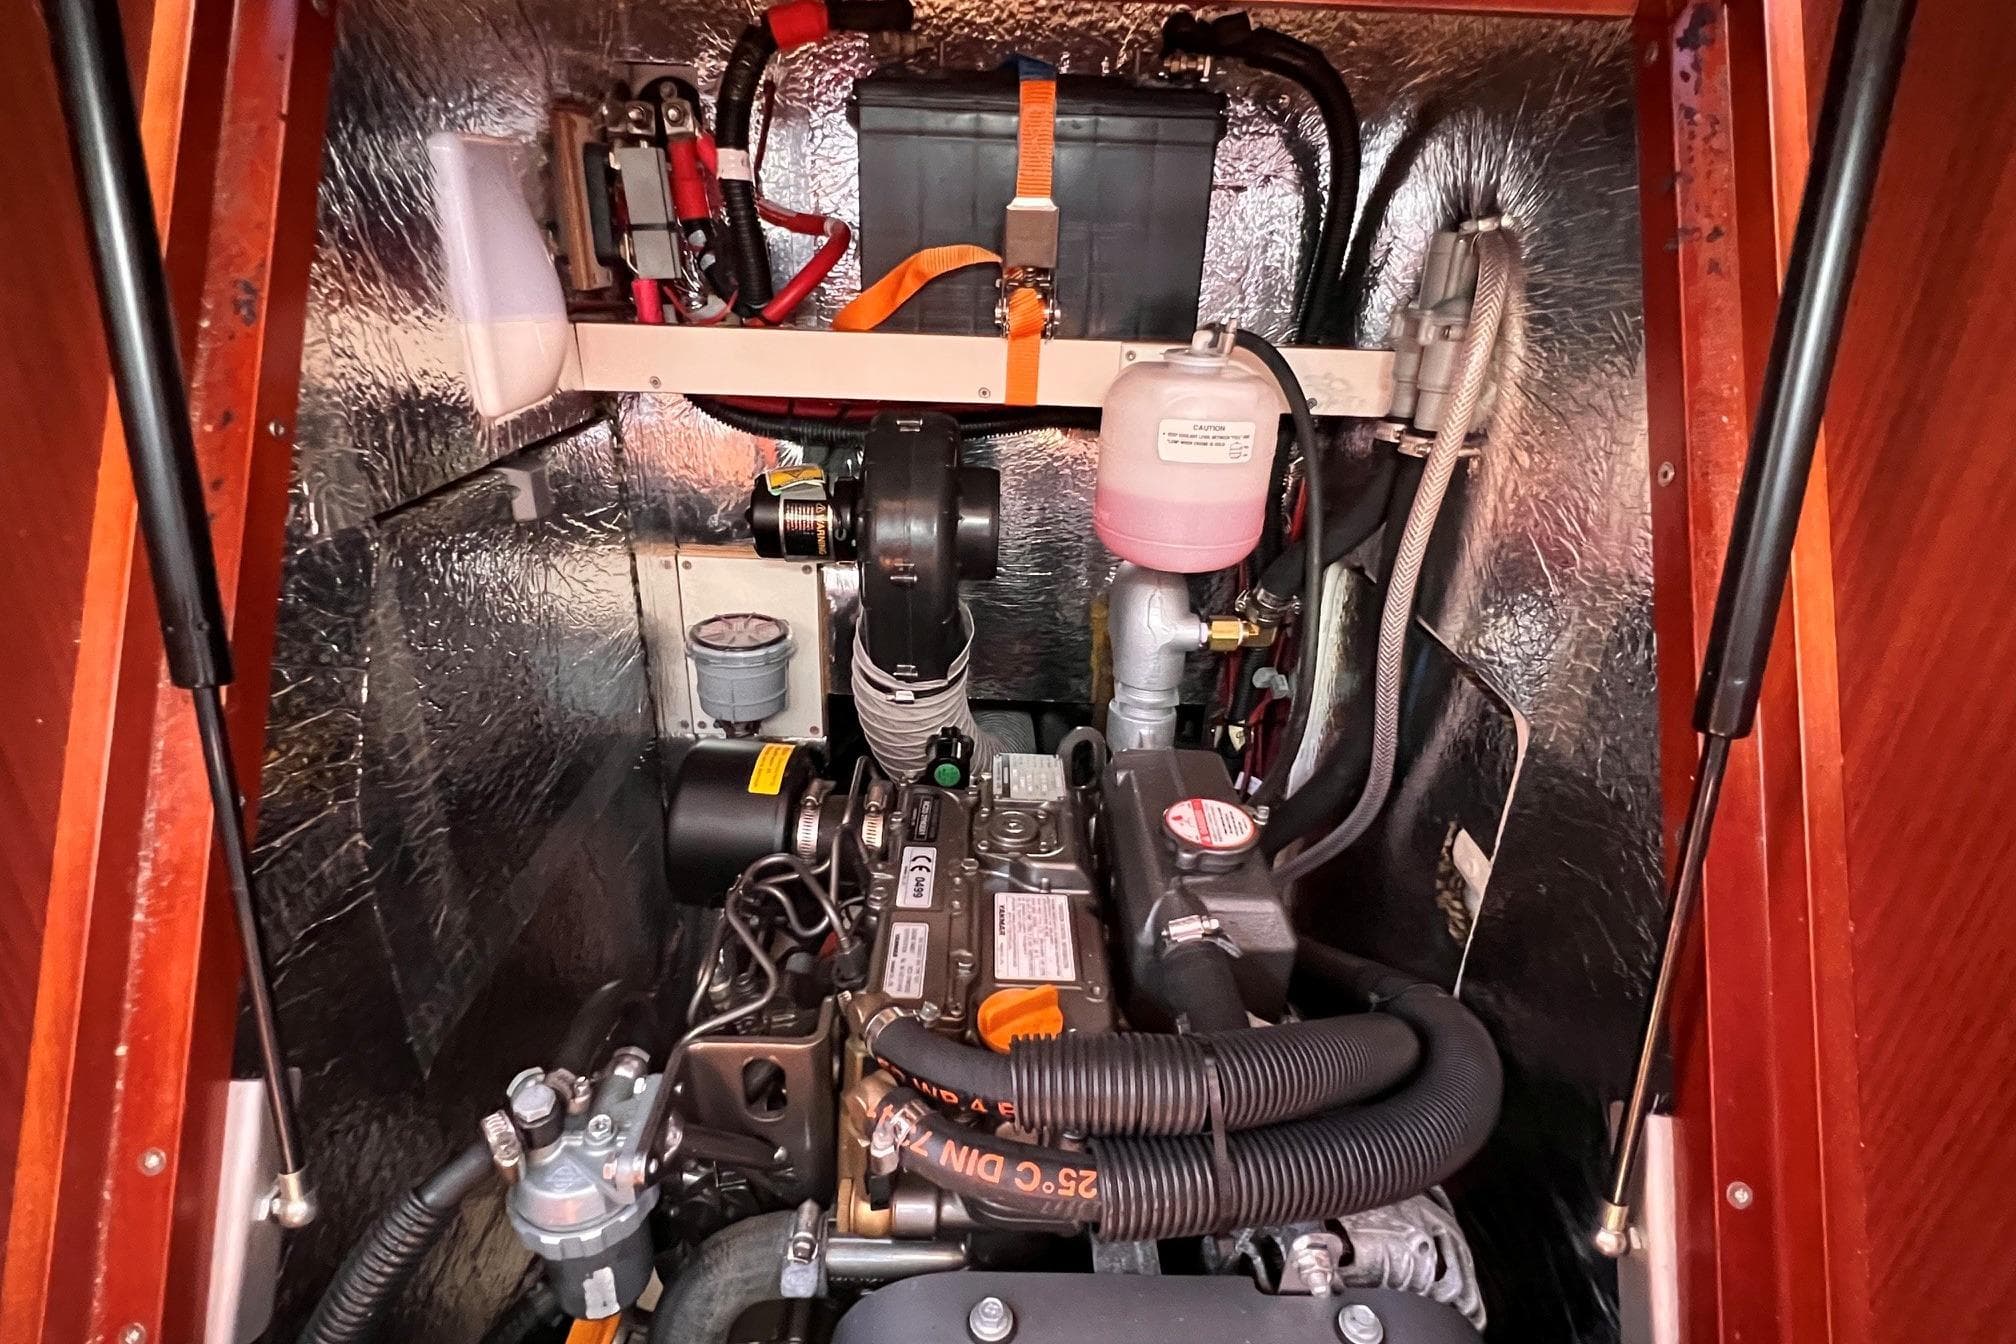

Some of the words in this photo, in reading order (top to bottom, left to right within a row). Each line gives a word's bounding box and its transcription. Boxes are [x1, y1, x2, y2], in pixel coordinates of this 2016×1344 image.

[1193, 424, 1226, 432] CAUTION
[816, 513, 828, 555] WARNING
[913, 876, 926, 898] 0499
[998, 905, 1006, 936] YANMAR
[939, 1139, 1004, 1184] DIN
